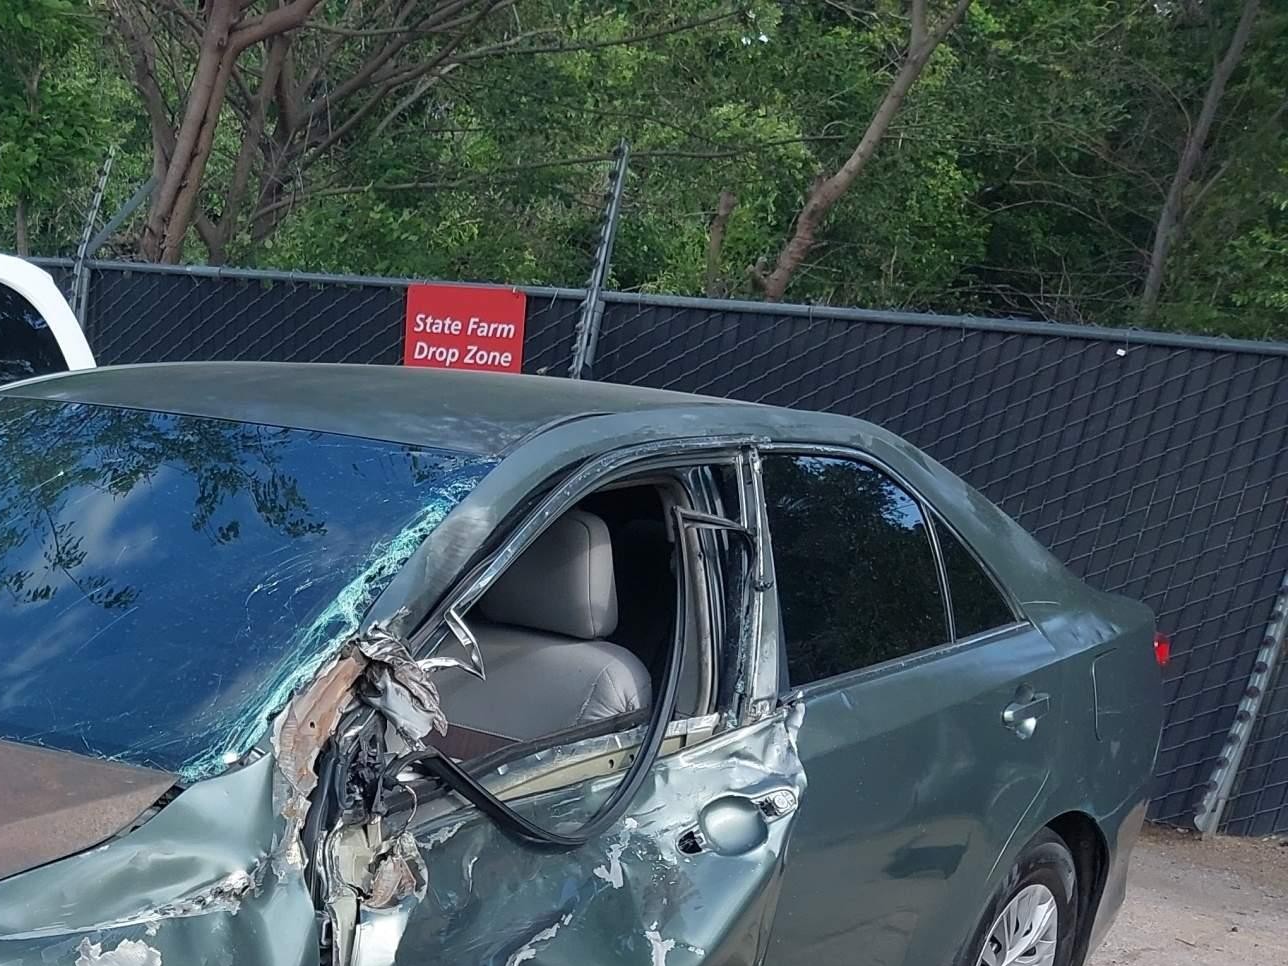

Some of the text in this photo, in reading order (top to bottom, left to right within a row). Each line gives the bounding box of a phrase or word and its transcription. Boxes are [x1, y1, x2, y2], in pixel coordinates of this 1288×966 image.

[414, 314, 516, 339] State Farm
[414, 341, 513, 367] Drop Zone
